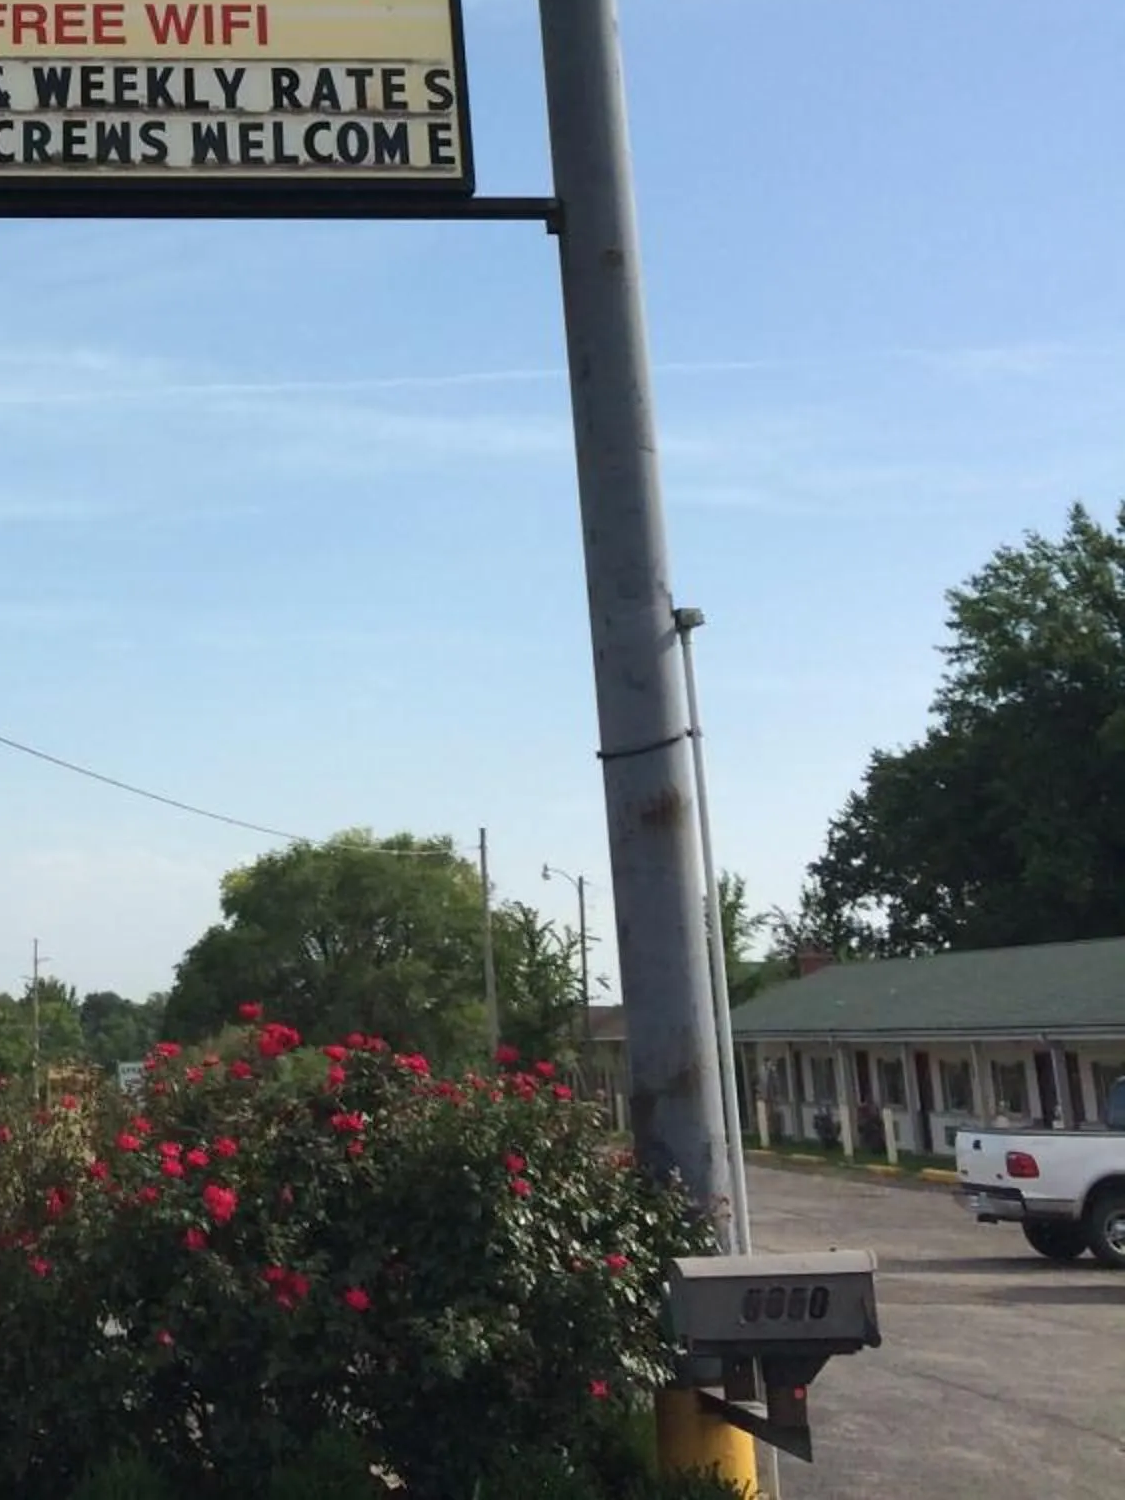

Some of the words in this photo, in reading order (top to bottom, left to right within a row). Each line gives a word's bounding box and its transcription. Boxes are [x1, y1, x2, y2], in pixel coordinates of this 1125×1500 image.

[144, 3, 268, 45] WIFI
[32, 65, 247, 110] WEEKLY
[271, 67, 455, 111] RATES
[191, 121, 456, 165] WELCOME
